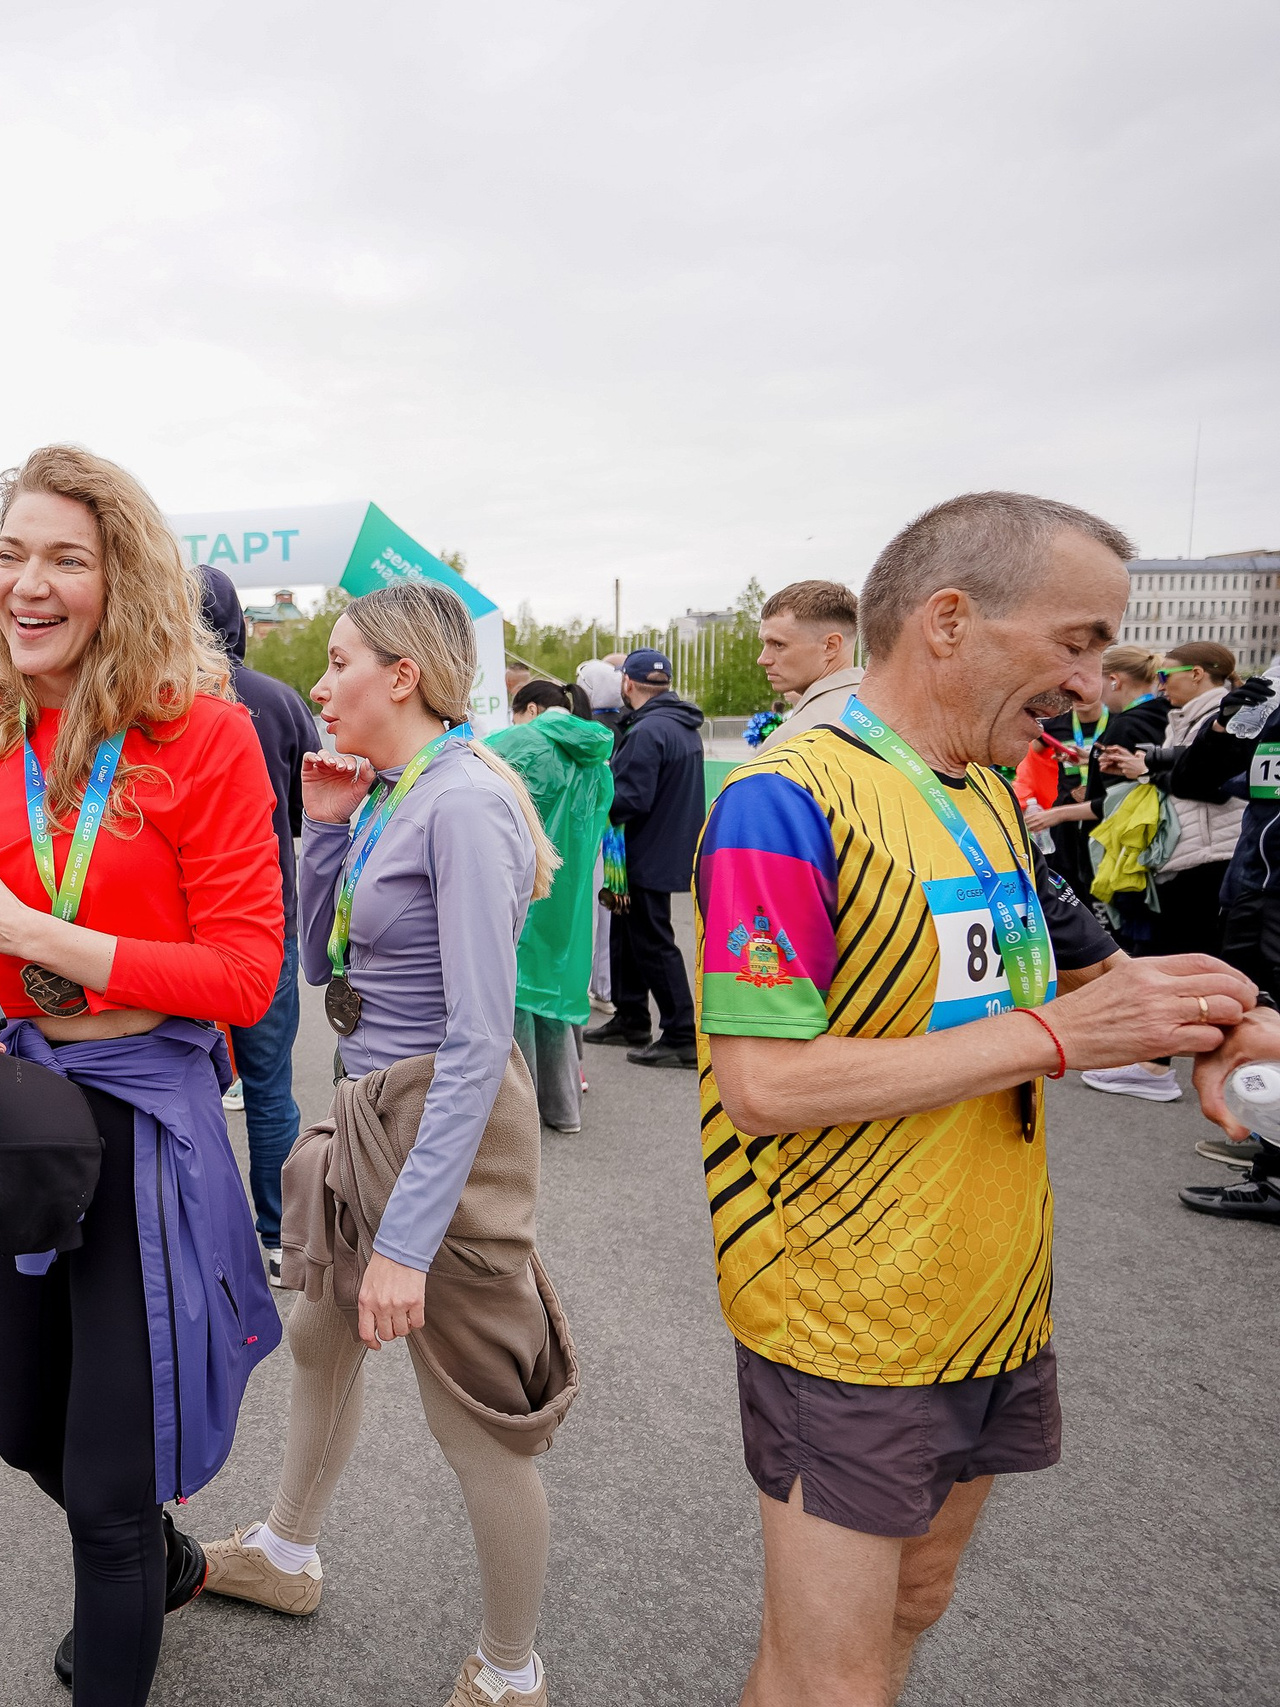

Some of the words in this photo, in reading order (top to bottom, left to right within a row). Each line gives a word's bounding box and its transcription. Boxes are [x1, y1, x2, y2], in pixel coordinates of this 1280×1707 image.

[181, 529, 300, 566] ТАРТ
[381, 546, 424, 580] зелё
[472, 696, 500, 715] ЕР
[849, 709, 873, 729] СБЕР
[890, 744, 910, 760] лет
[97, 765, 109, 783] Utair
[907, 759, 924, 776] 185
[35, 805, 44, 830] СБЕР
[82, 815, 95, 842] СБЕР
[74, 852, 84, 869] 185
[968, 845, 985, 867] Utair
[69, 870, 78, 888] лет
[997, 901, 1015, 930] СБЕР
[1027, 905, 1037, 934] СБЕР
[1016, 955, 1026, 974] лет
[1030, 946, 1041, 966] 185
[1022, 977, 1030, 995] 185
[1032, 967, 1043, 989] лет
